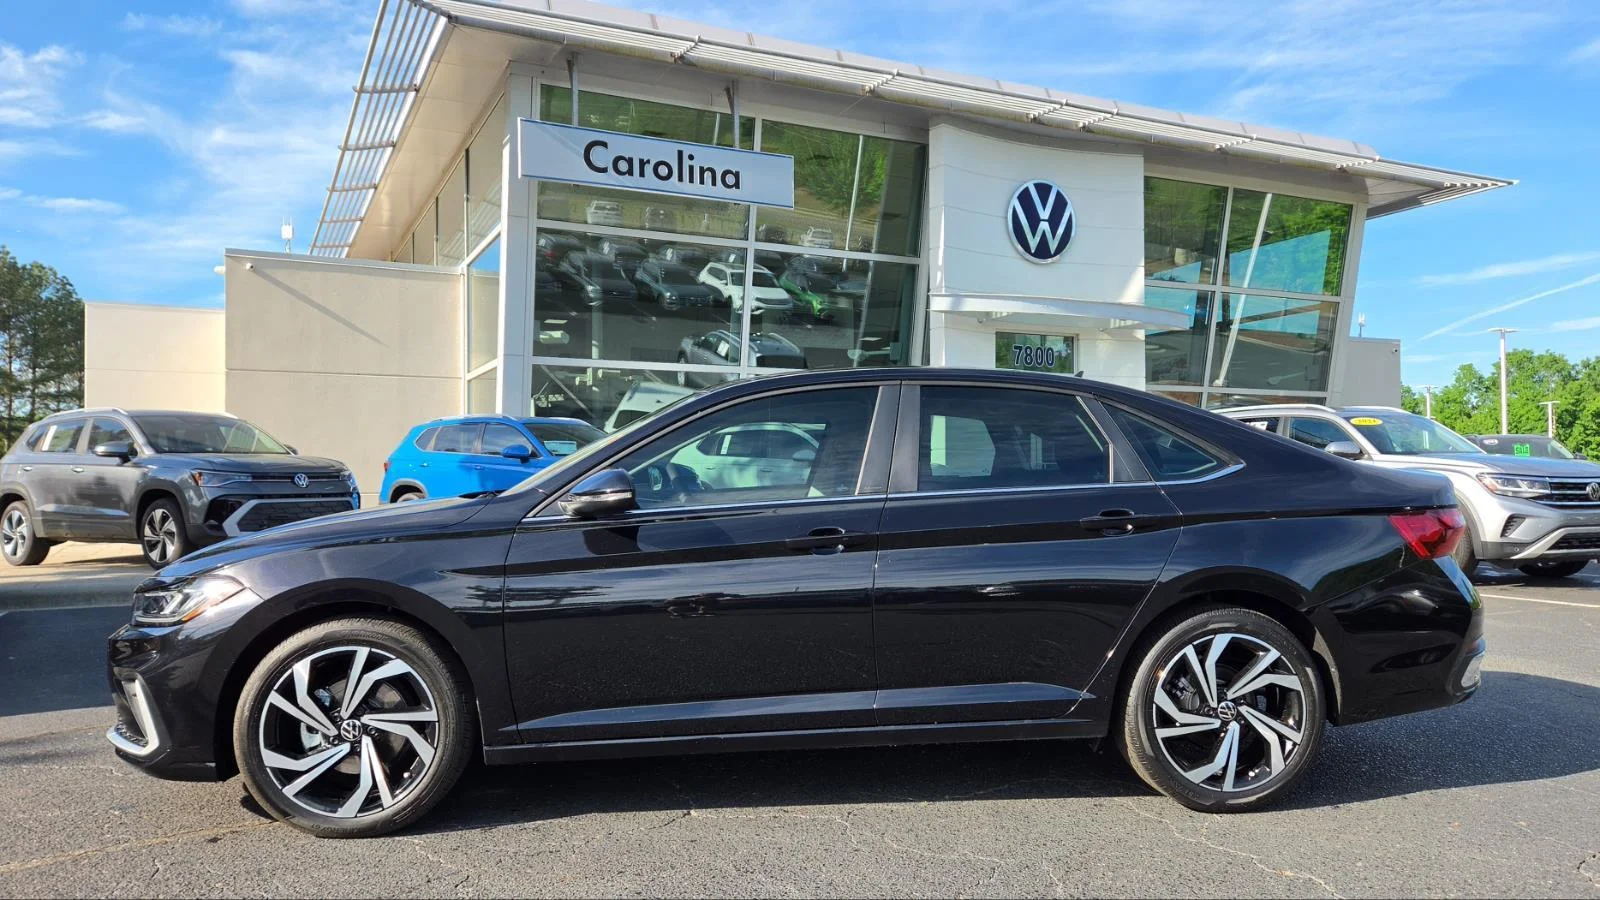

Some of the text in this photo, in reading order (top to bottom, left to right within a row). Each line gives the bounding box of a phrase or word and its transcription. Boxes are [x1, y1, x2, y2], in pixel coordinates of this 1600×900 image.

[583, 140, 741, 190] Carolina
[1010, 180, 1074, 259] VW
[1013, 344, 1055, 367] 7800
[341, 719, 362, 741] VW
